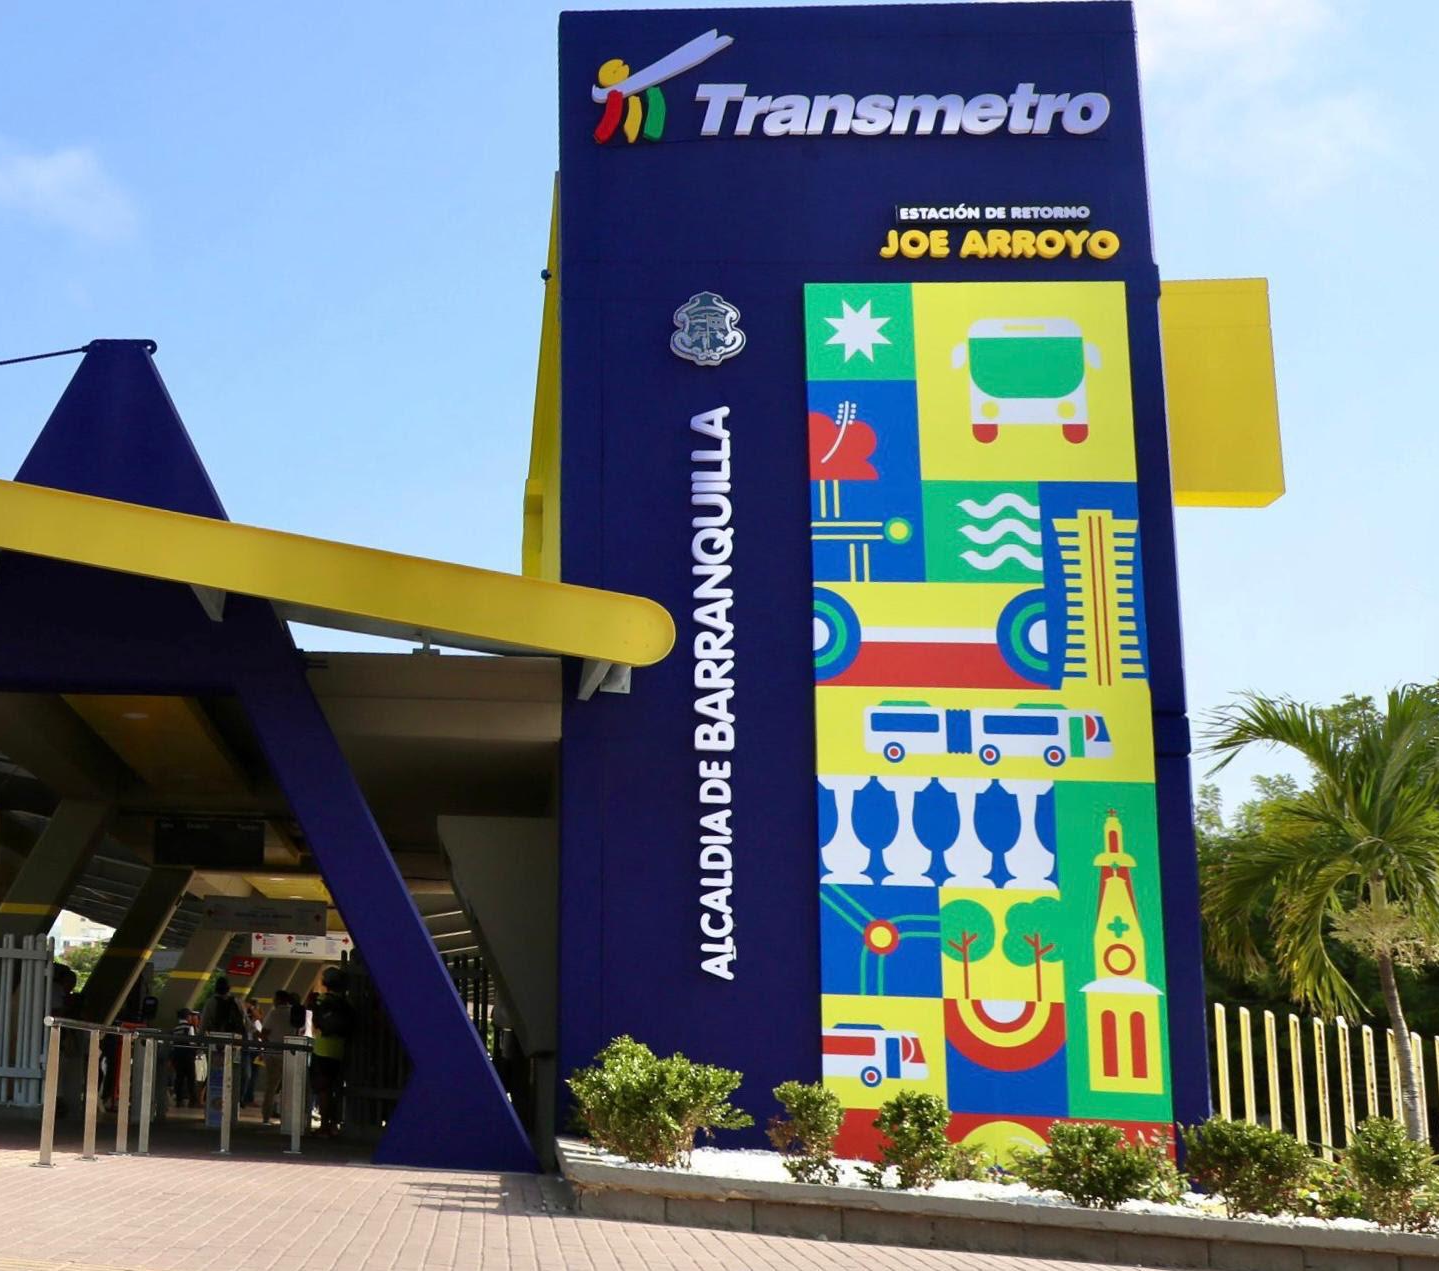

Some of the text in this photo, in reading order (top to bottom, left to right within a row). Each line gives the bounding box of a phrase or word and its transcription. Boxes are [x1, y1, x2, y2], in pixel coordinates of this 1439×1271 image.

[696, 83, 1111, 137] Transmetro
[899, 203, 1091, 220] ESTACIÓN DE RETORNO
[880, 229, 1120, 259] JOE ARROYO
[691, 406, 735, 981] ALCALDIA DE BARRANQUILLA
